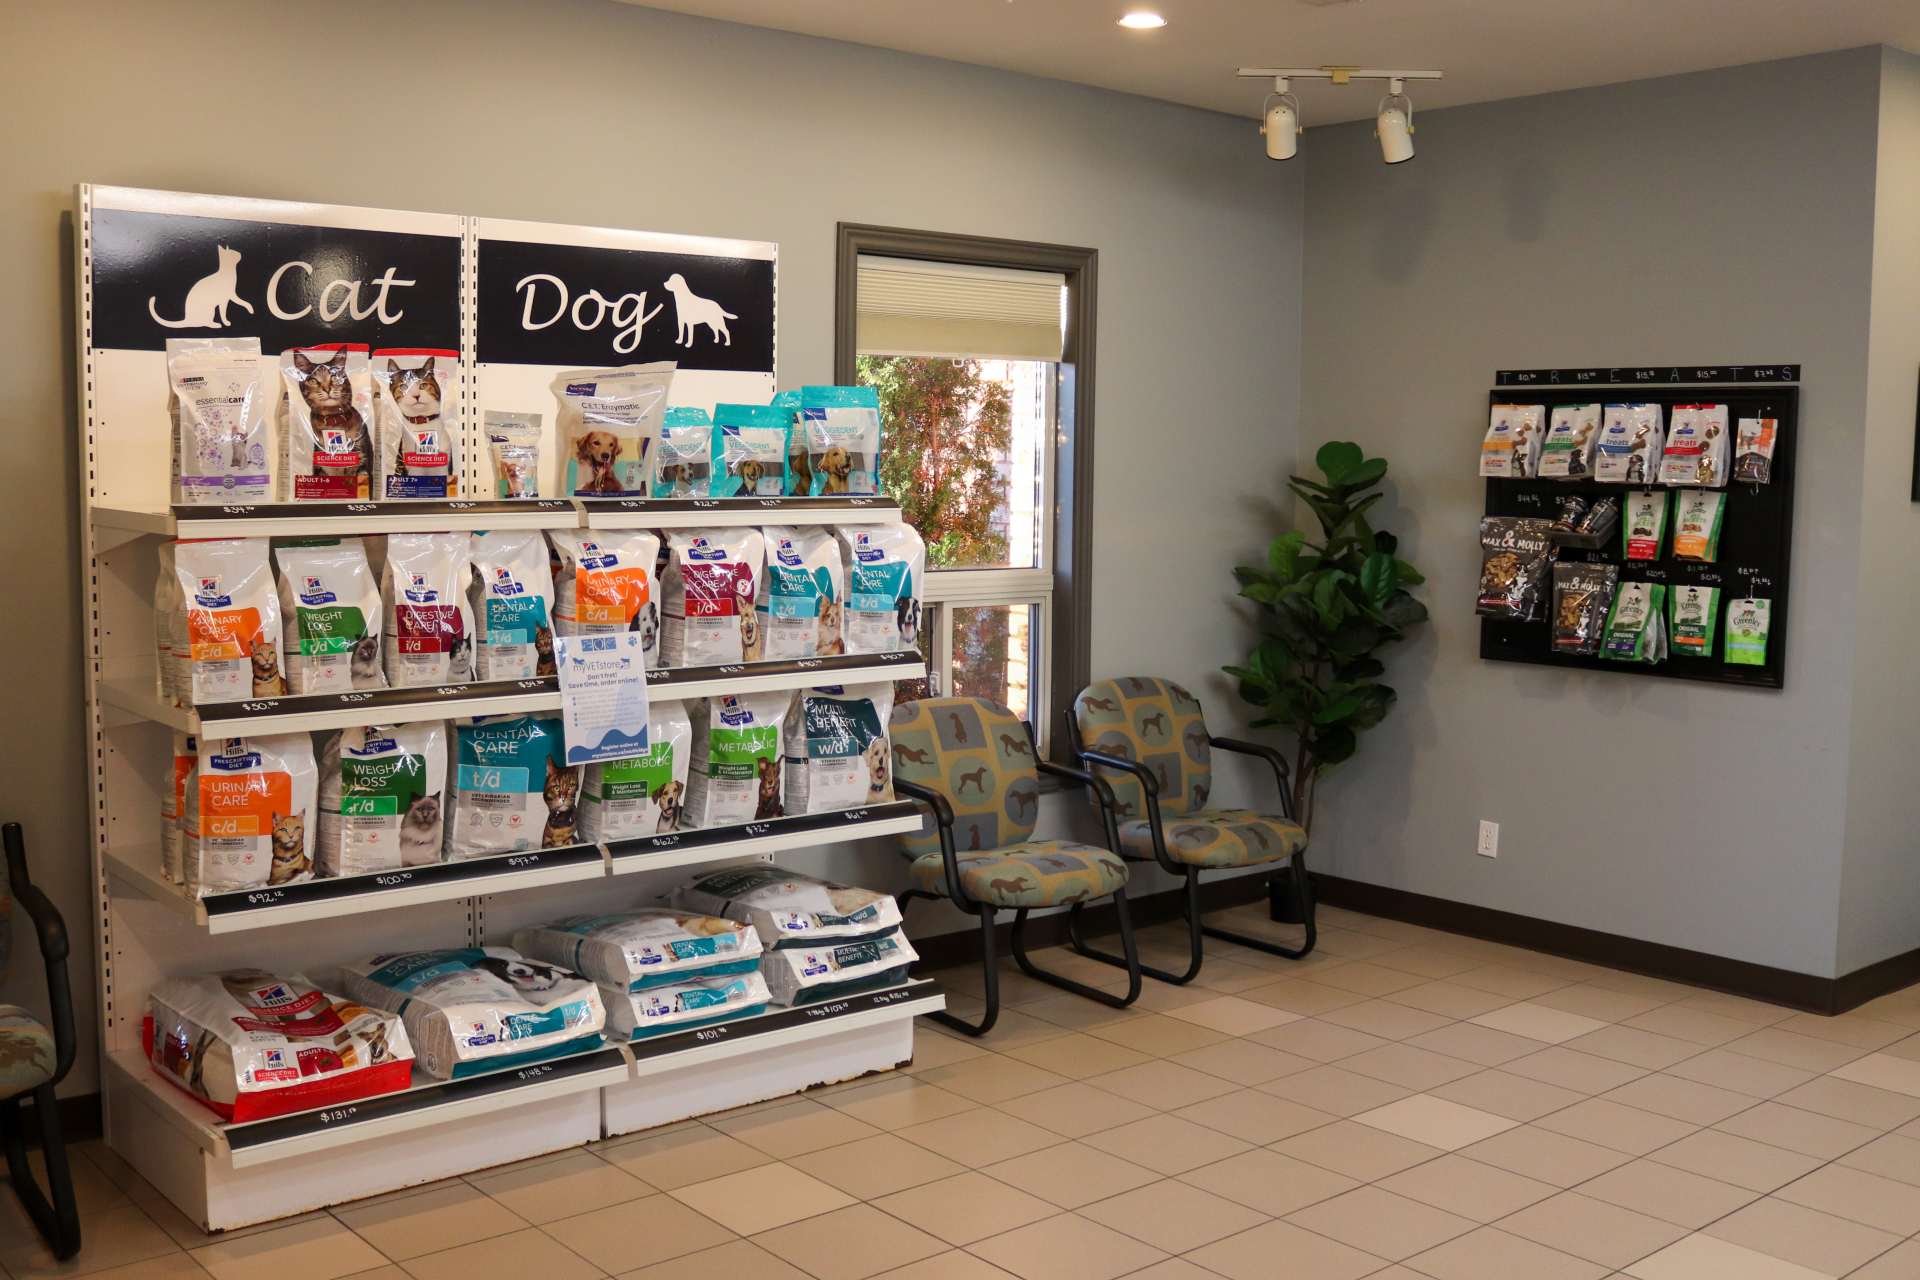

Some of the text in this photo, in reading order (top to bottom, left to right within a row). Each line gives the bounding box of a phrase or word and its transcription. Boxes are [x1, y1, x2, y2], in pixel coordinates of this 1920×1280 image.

[266, 261, 416, 325] Cat
[515, 273, 664, 354] Dog
[602, 402, 640, 411] Enzymatic
[1606, 438, 1629, 446] treats
[1673, 438, 1696, 446] treats
[1482, 530, 1545, 554] MAX & MOLLY
[693, 568, 739, 579] DIGESVE
[780, 582, 805, 592] CARE
[1558, 581, 1569, 589] MAX
[1580, 581, 1601, 591] MOLLY
[493, 602, 529, 612] DENTAL
[198, 614, 242, 626] URINARY
[305, 611, 344, 622] WEIGHT
[493, 613, 521, 623] CARE
[586, 608, 608, 621] c/d
[200, 626, 228, 636] CARE
[307, 622, 333, 632] LOSS
[309, 640, 328, 654] r/d
[405, 640, 421, 651] i/d
[201, 646, 222, 659] c/d
[816, 718, 857, 729] BENEFIT
[473, 740, 519, 754] CARE
[818, 740, 844, 755] w/d
[214, 755, 262, 765] PRESCRIPTION
[612, 756, 670, 770] METABOLIC
[354, 776, 387, 787] LOSS
[472, 769, 501, 788] t/d
[211, 780, 270, 793] URINARY
[211, 795, 249, 806] CARE
[211, 820, 237, 834] c/d
[838, 952, 863, 963] BENEFIT
[298, 1048, 322, 1058] ADULT
